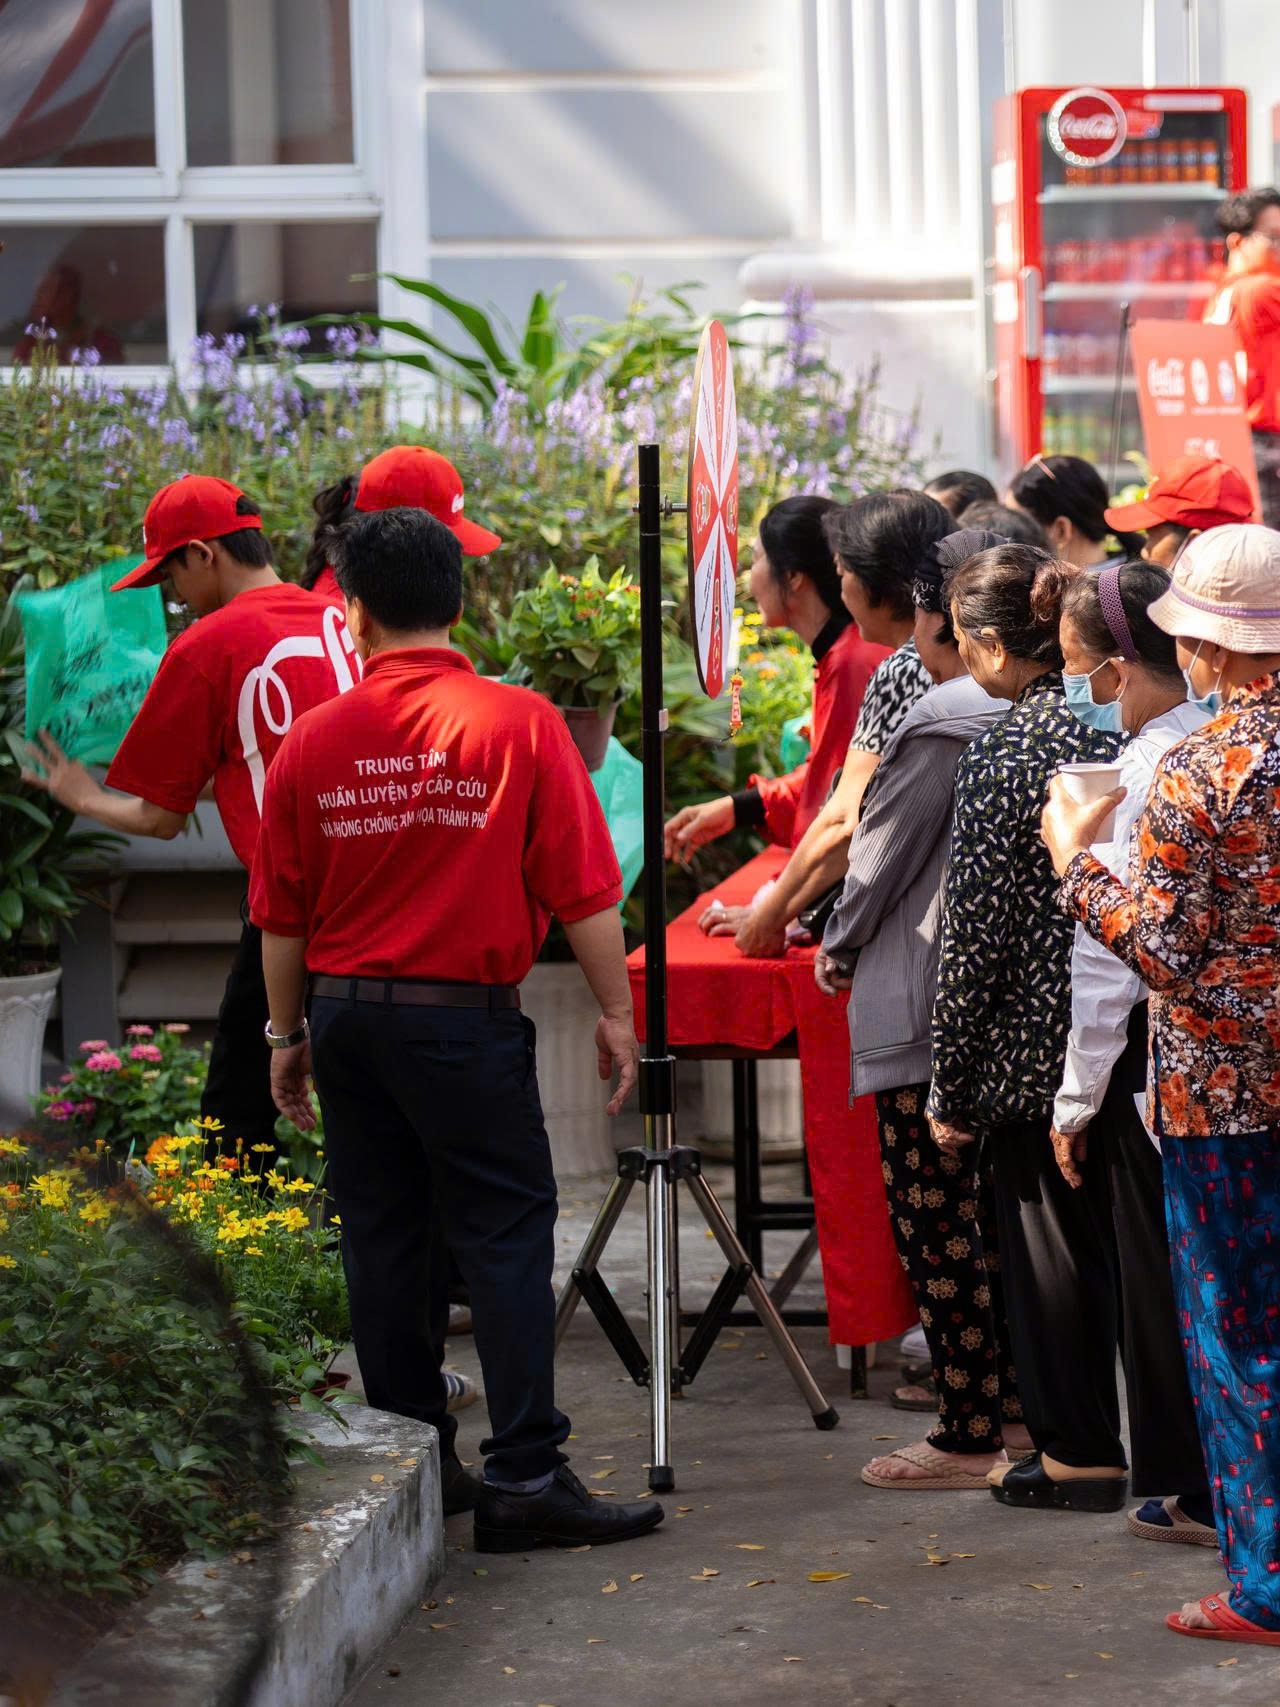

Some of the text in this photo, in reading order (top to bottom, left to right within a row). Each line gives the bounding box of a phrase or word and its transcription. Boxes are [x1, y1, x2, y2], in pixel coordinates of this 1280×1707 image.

[355, 748, 447, 776] TRUNG TÂM
[317, 785, 356, 810] HUẤN
[360, 780, 408, 806] LUYỆN
[426, 774, 453, 795] CẤP
[456, 776, 487, 799] CỨU
[364, 811, 399, 835] CHỐNG
[416, 807, 435, 827] HỌA
[437, 803, 469, 827] THÀNH
